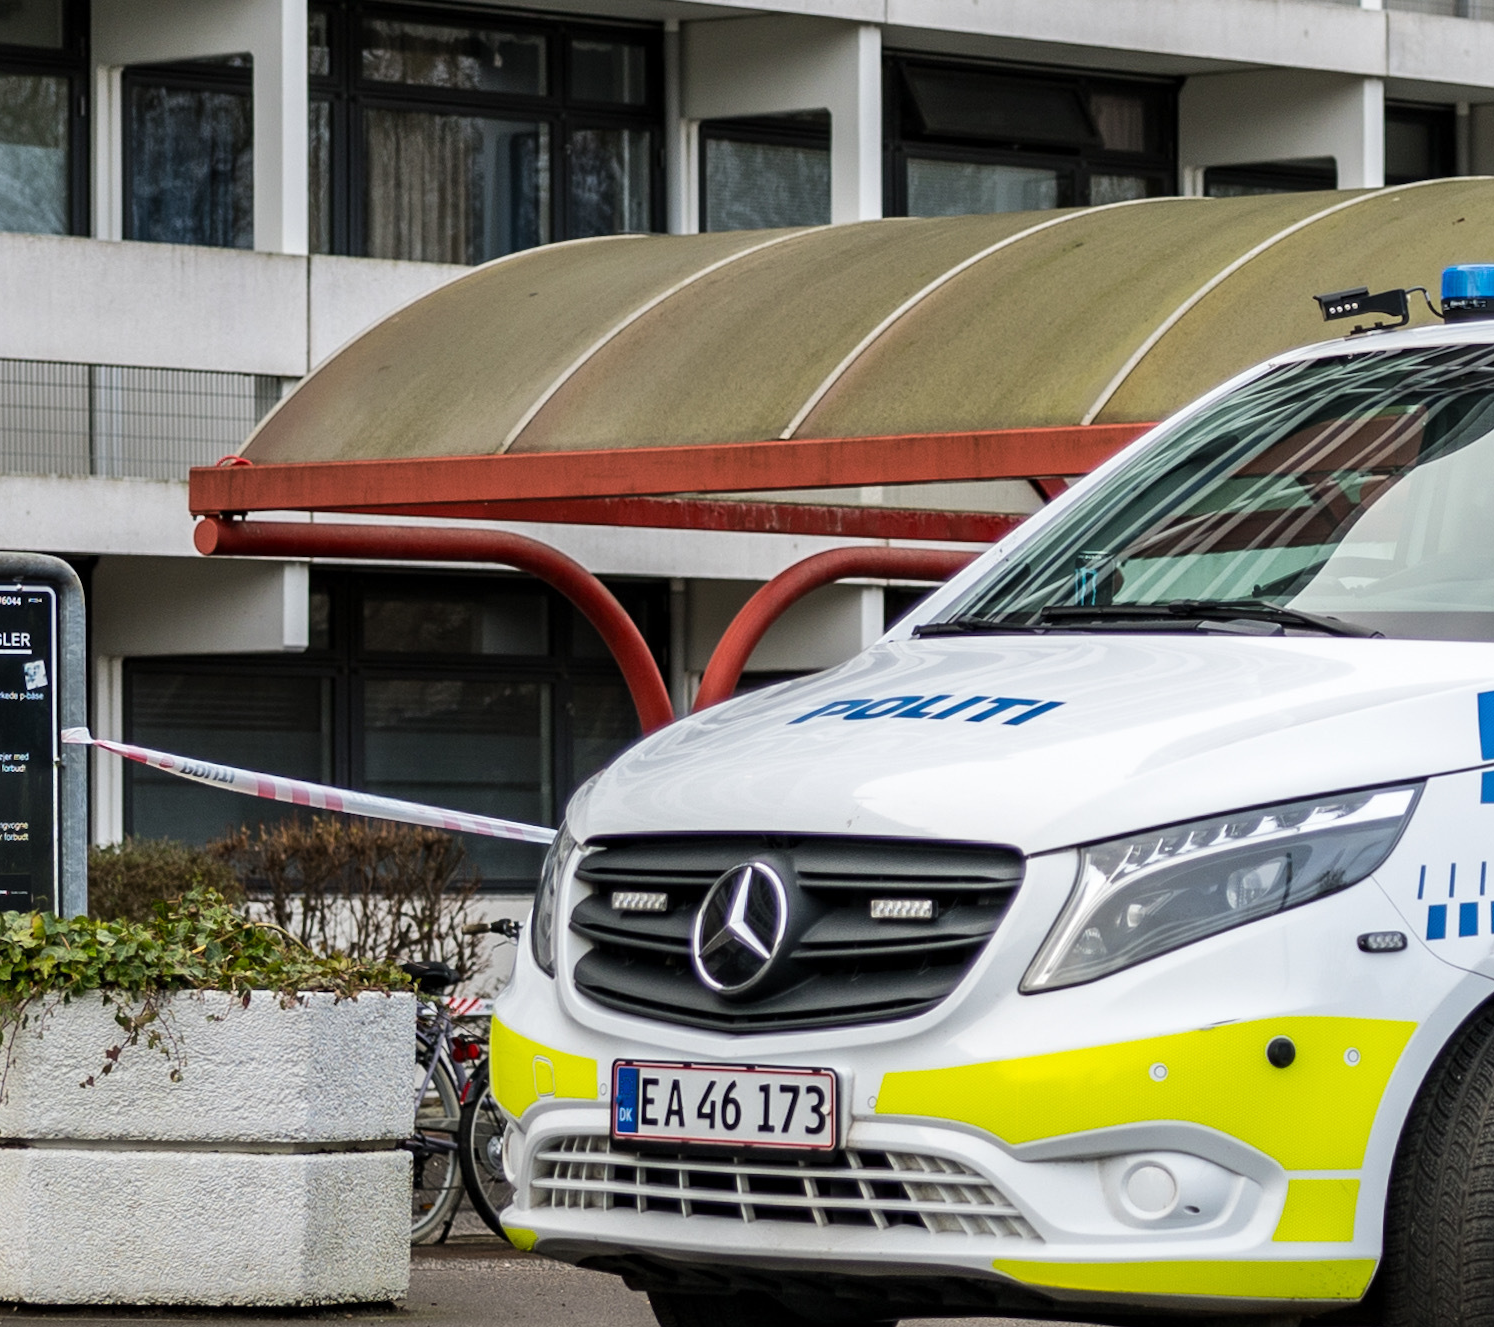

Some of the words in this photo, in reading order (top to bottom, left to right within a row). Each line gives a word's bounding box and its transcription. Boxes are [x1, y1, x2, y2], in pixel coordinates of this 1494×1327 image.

[786, 694, 1067, 726] POLITI
[619, 1108, 633, 1122] DK
[641, 1077, 685, 1127] EA
[697, 1079, 742, 1131] 46
[757, 1083, 826, 1135] 173
